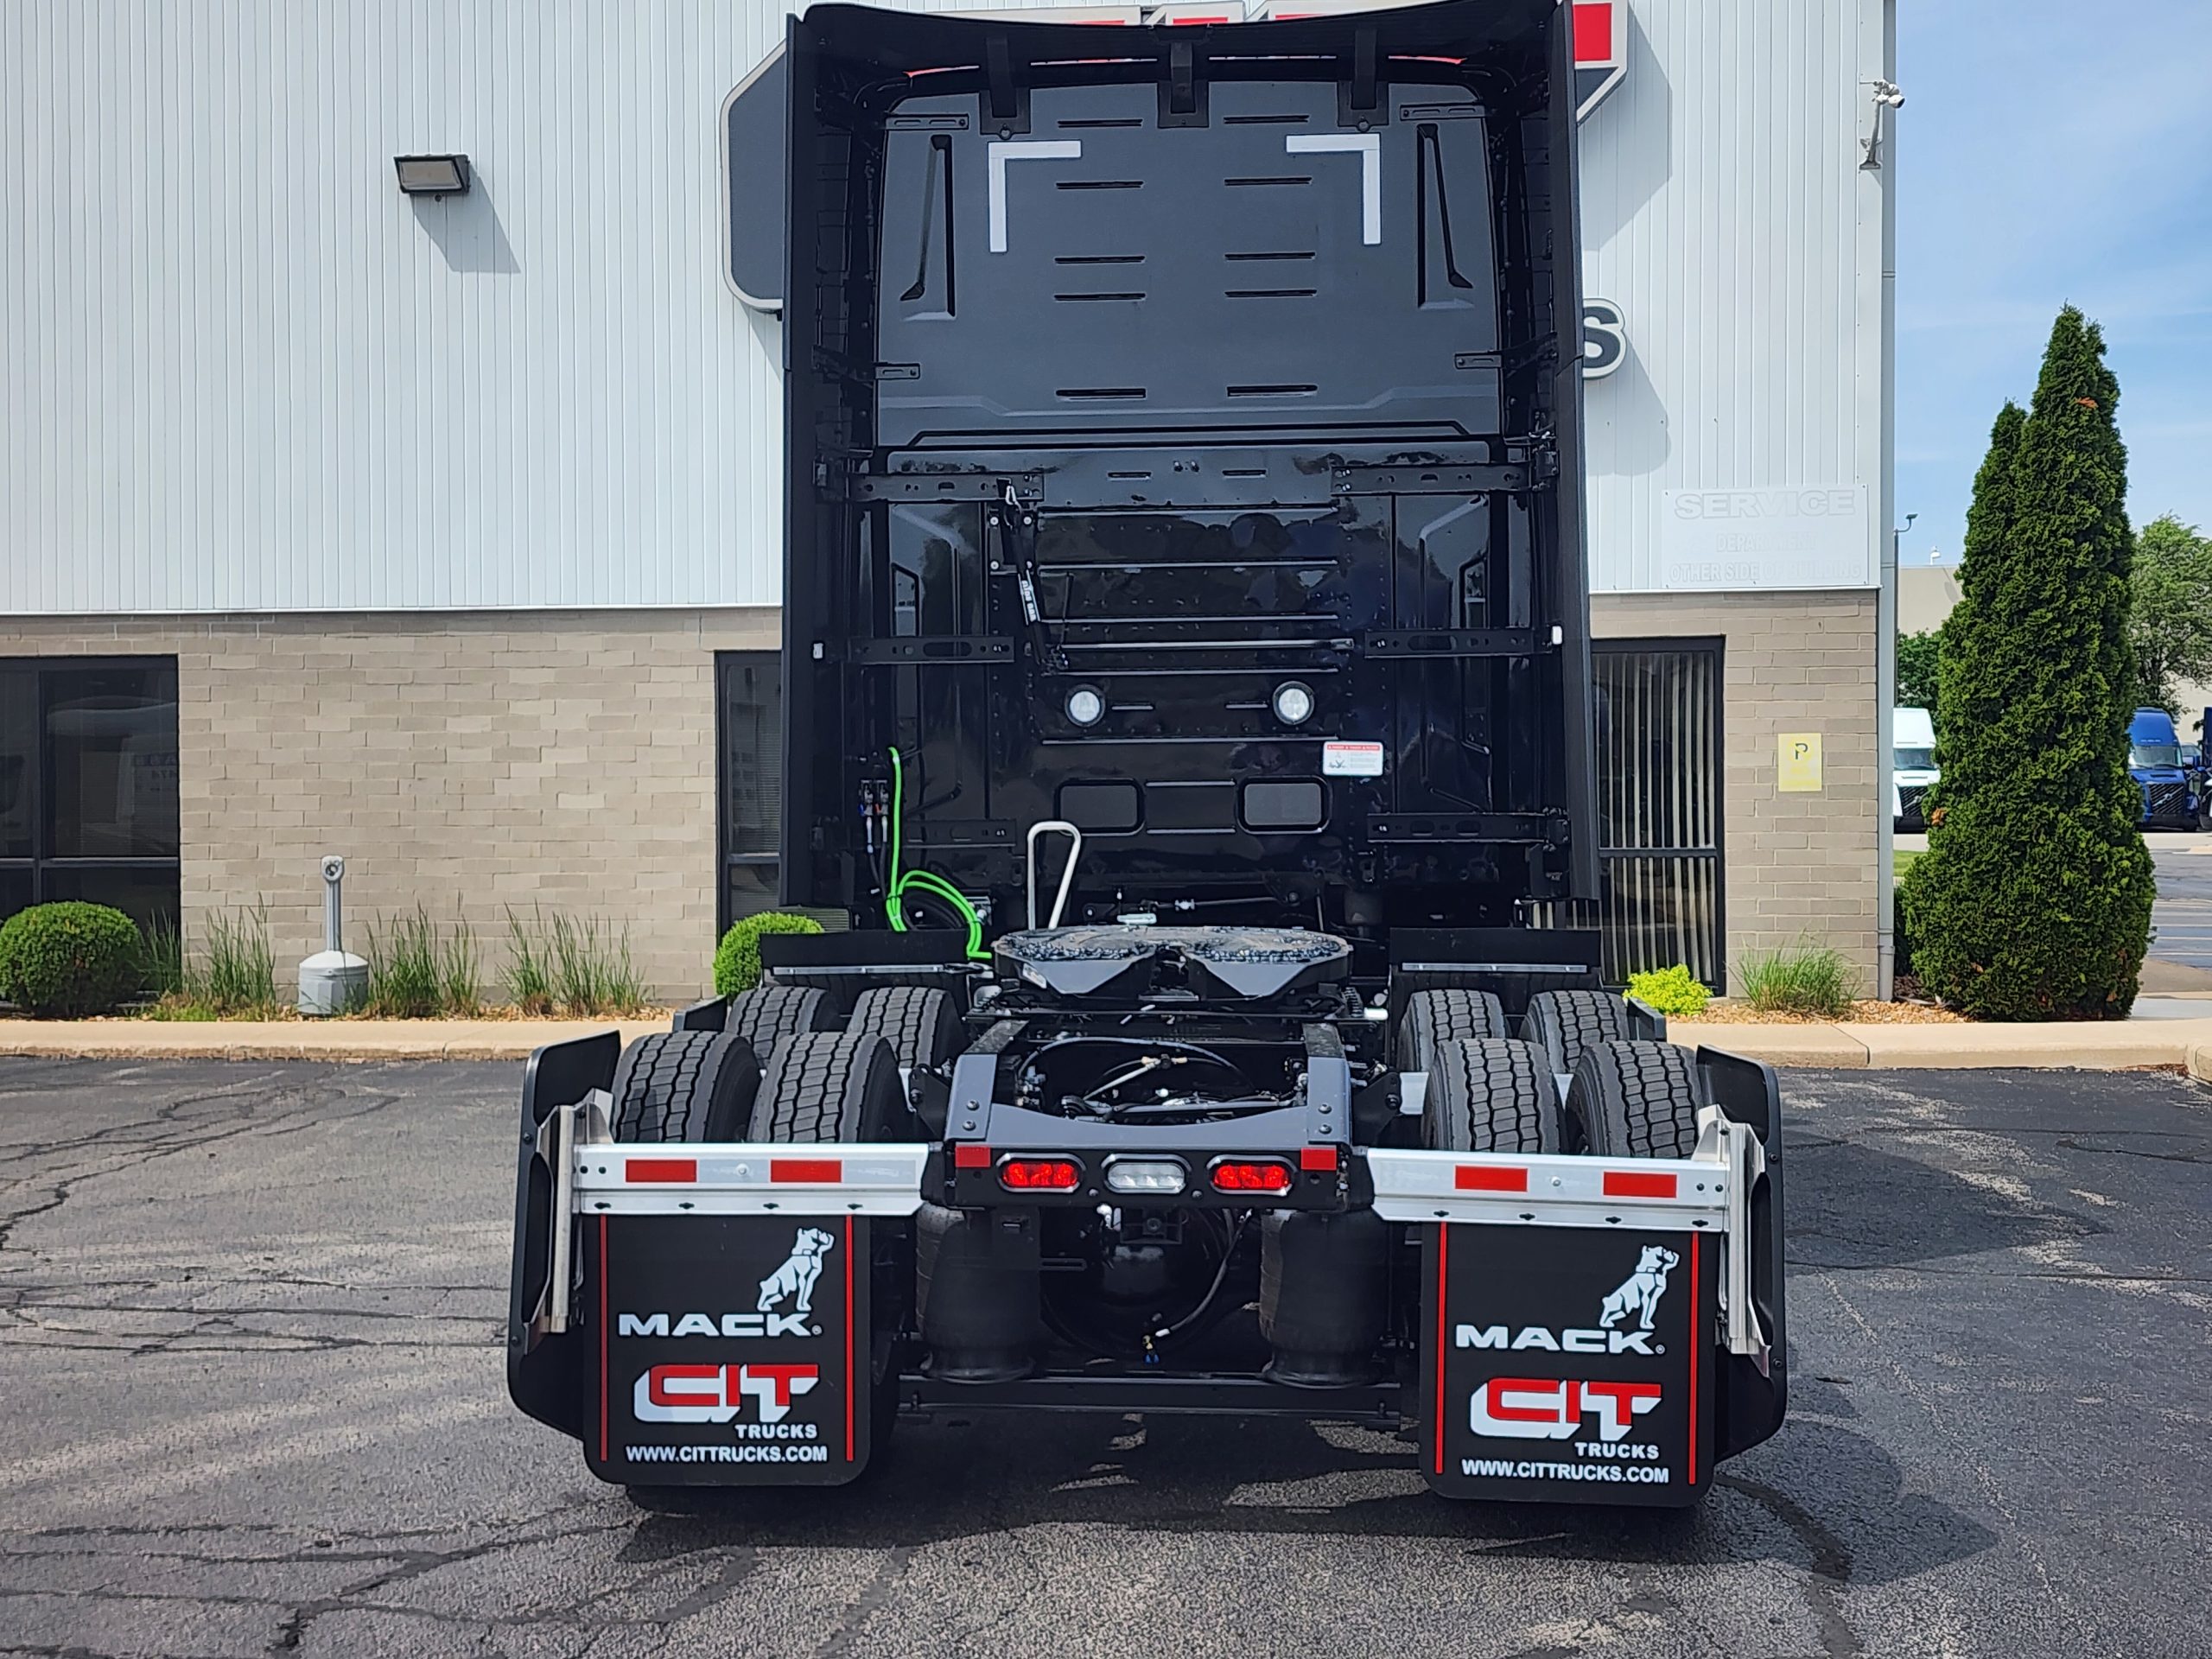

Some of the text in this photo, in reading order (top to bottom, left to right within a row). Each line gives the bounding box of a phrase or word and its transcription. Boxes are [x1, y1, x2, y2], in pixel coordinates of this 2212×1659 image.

[1674, 489, 1856, 520] SERVICE
[1669, 563, 1722, 582] OTHER
[1726, 562, 1760, 582] SIDE
[634, 1363, 819, 1423] CIT
[1471, 1377, 1662, 1441] CIT
[734, 1424, 818, 1440] TRUCKS
[625, 1446, 828, 1462] WWW.CITTRUCKS.COM
[1574, 1442, 1659, 1459] TRUCKS
[1461, 1459, 1669, 1484] WWW.CITTRUCKS.COM
